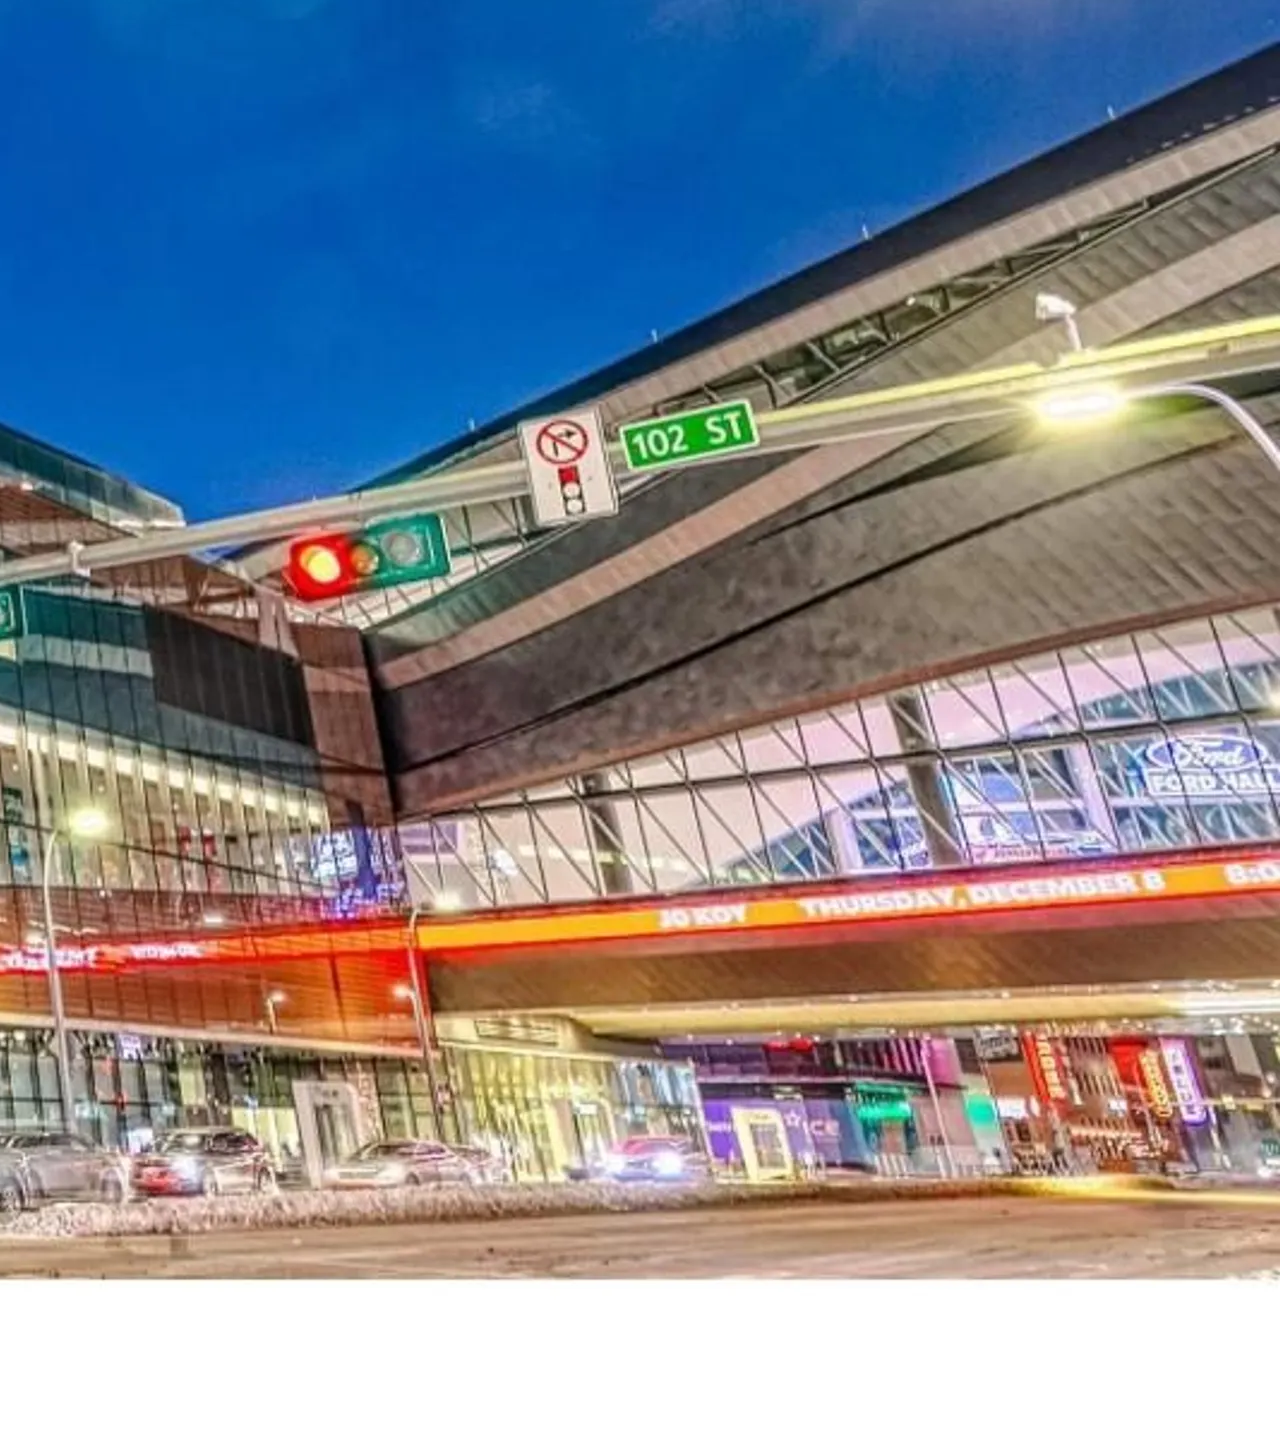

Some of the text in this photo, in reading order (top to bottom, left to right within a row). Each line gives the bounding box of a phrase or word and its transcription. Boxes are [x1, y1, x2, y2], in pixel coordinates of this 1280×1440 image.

[631, 411, 742, 459] 102 ST
[1152, 773, 1216, 793] FORD
[660, 907, 689, 928] JO
[692, 904, 748, 925] KOY
[968, 872, 1137, 904] DECEMBER
[1143, 869, 1165, 892] 8
